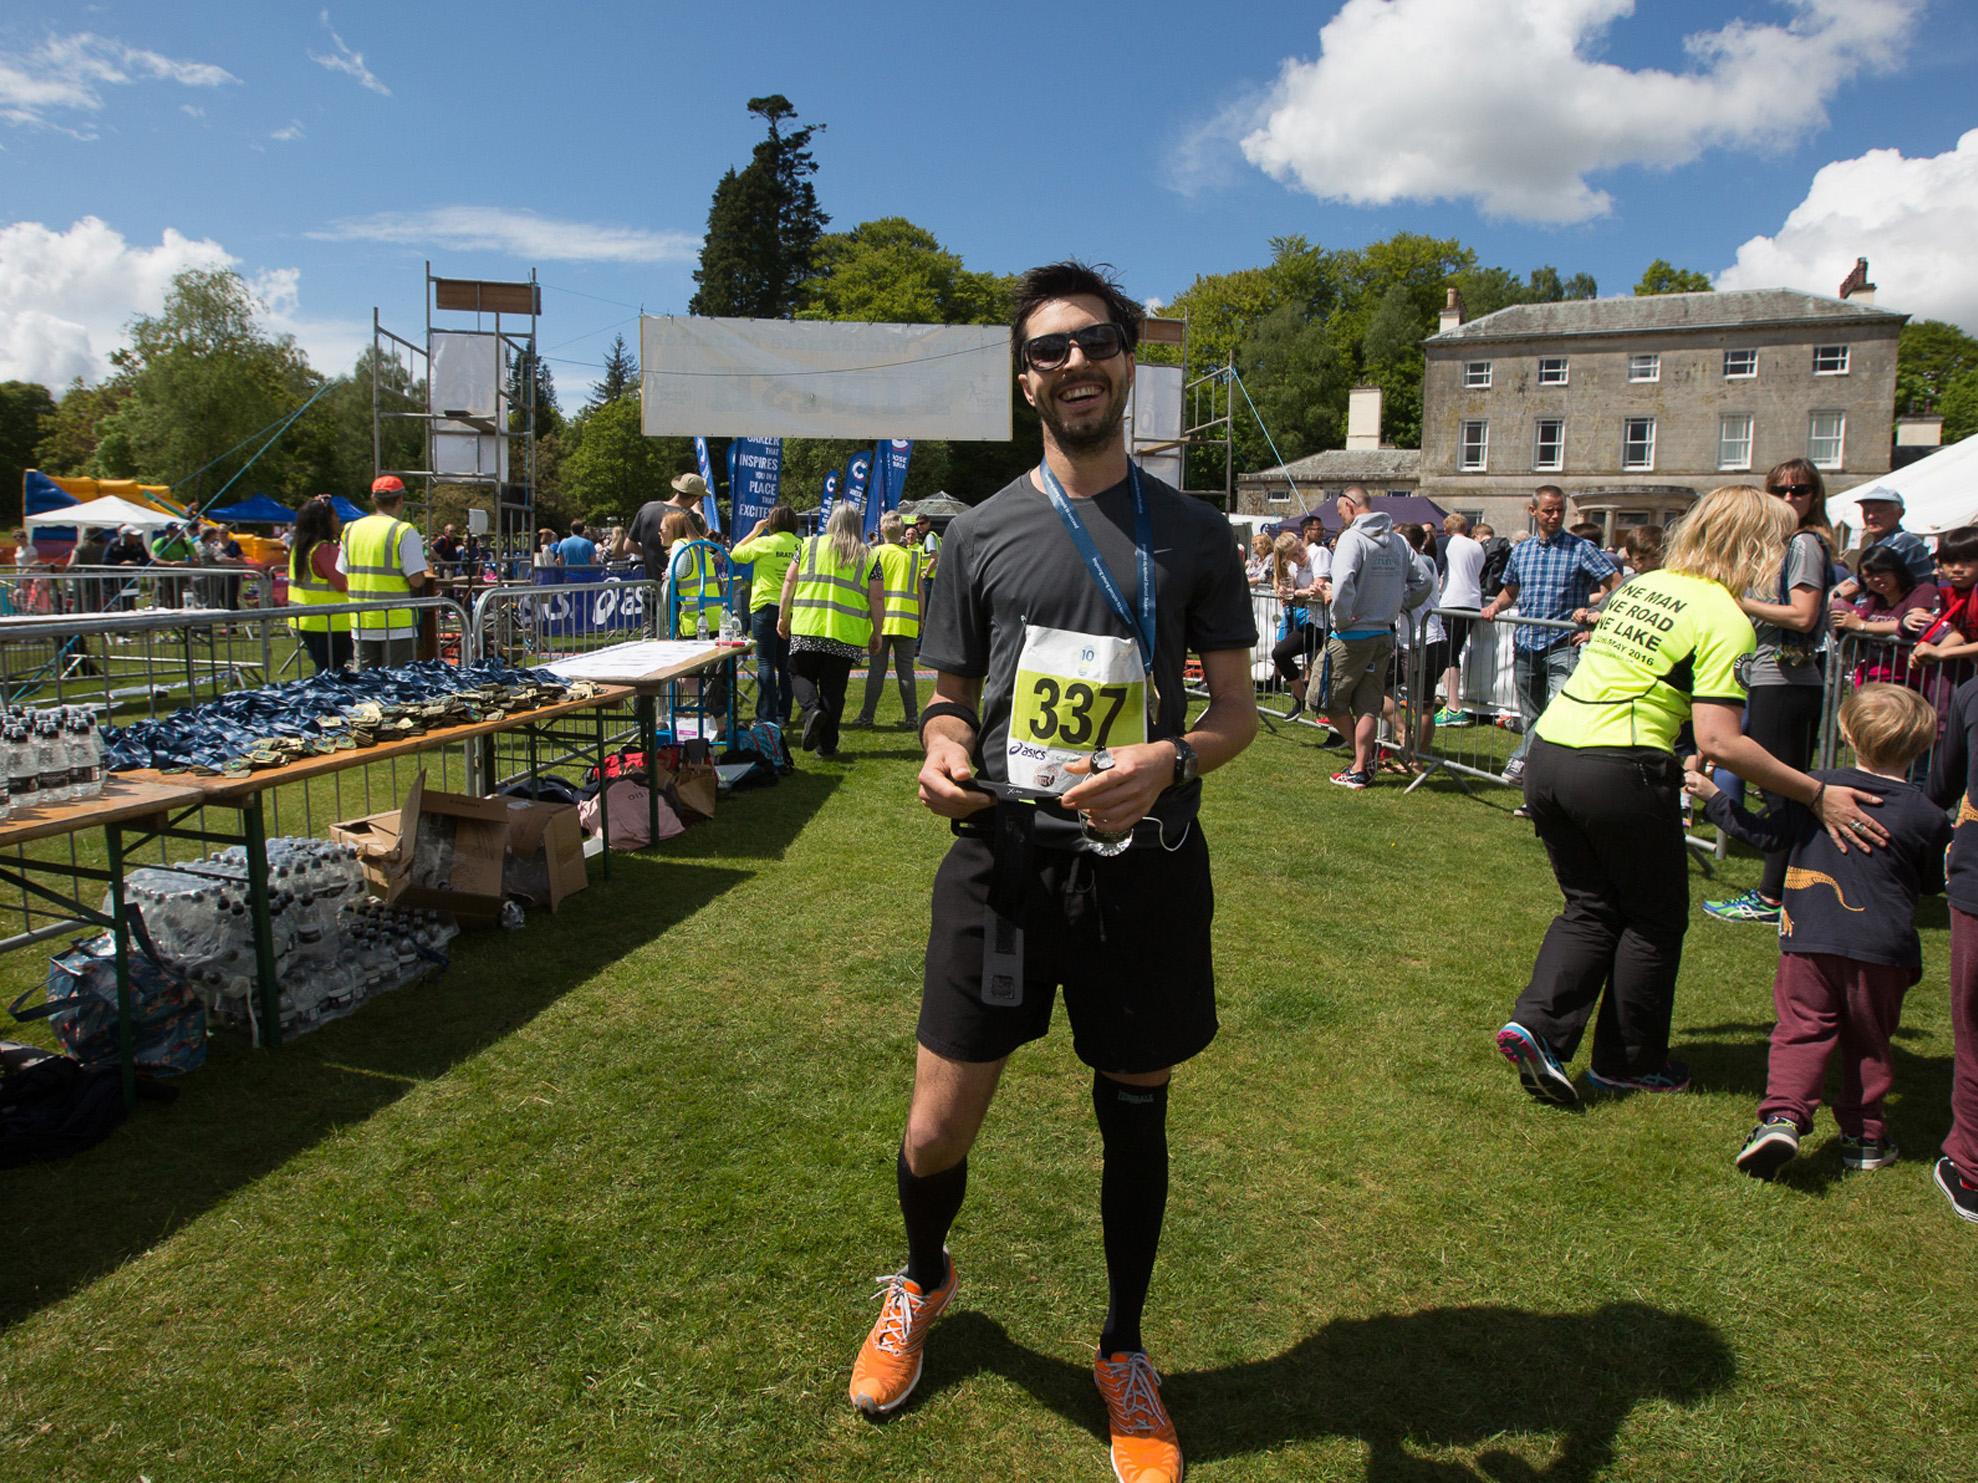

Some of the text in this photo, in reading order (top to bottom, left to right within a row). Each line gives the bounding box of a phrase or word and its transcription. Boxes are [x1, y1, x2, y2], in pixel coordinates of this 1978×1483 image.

[766, 448, 779, 456] THAT
[739, 454, 778, 470] INSPIRES
[749, 480, 776, 496] PLACE
[762, 496, 776, 505] THAT
[1620, 584, 1687, 613] NE MAN
[1608, 600, 1674, 632] NE ROAD
[1599, 616, 1662, 652] NE LAKE
[1081, 650, 1095, 662] 10
[1628, 648, 1654, 666] 2016
[1029, 677, 1128, 751] 337
